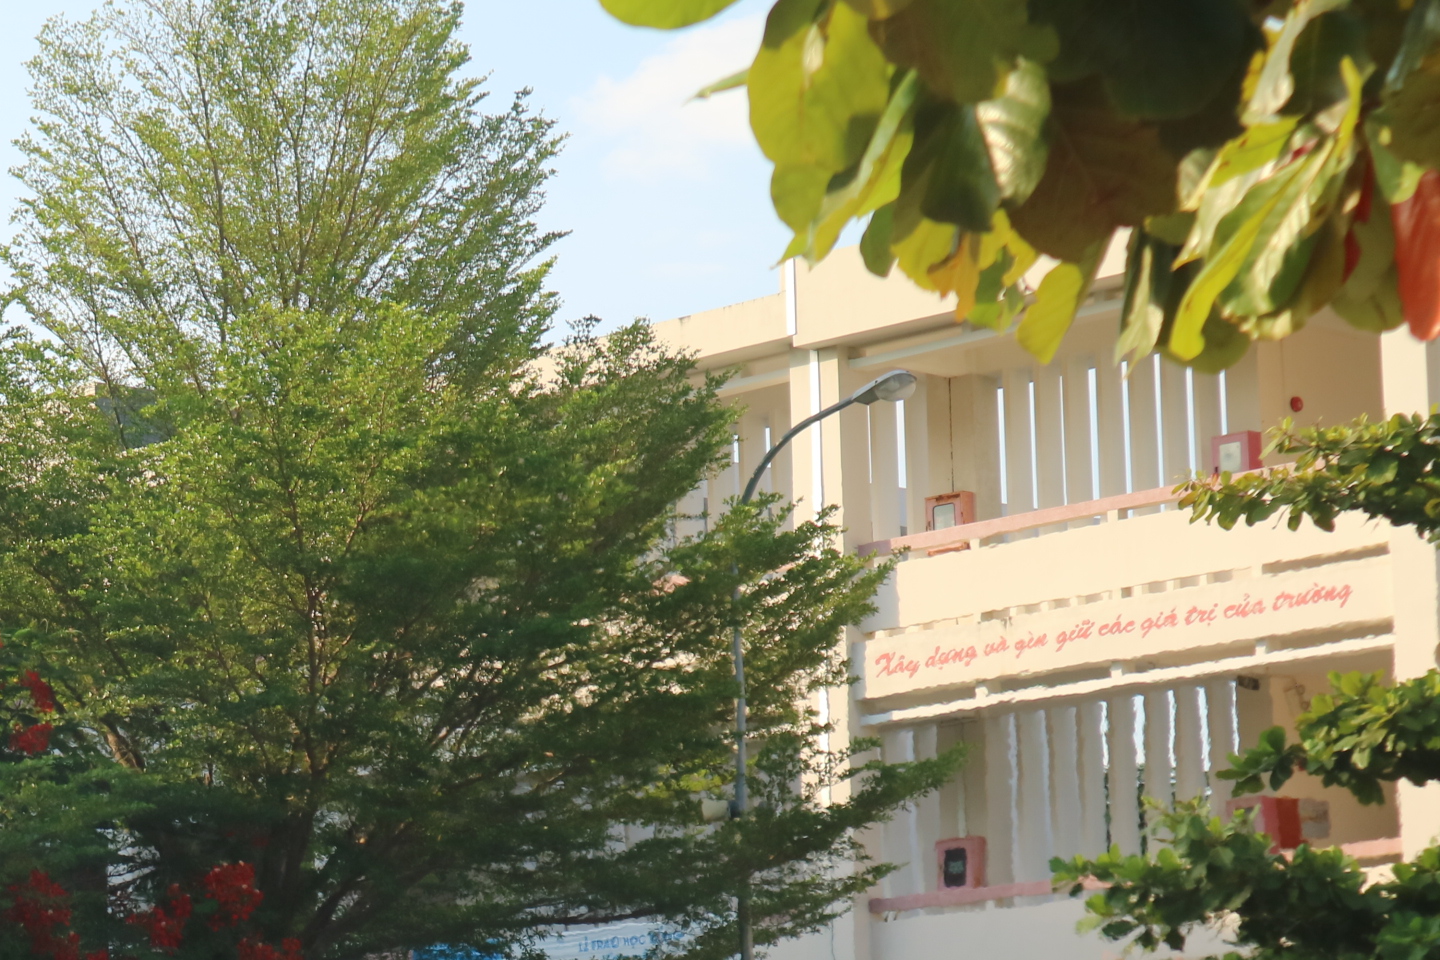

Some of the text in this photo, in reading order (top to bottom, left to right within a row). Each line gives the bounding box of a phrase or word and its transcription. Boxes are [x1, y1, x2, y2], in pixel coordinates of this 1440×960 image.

[874, 651, 921, 679] Xây
[924, 645, 978, 671] dựng
[983, 635, 1011, 657] và
[1055, 618, 1097, 653] giữ
[1097, 613, 1137, 638] các
[1139, 606, 1180, 639] giá
[1183, 602, 1219, 627] trị
[1222, 592, 1266, 620] của
[1271, 581, 1354, 609] trường
[623, 934, 647, 948] HỌC
